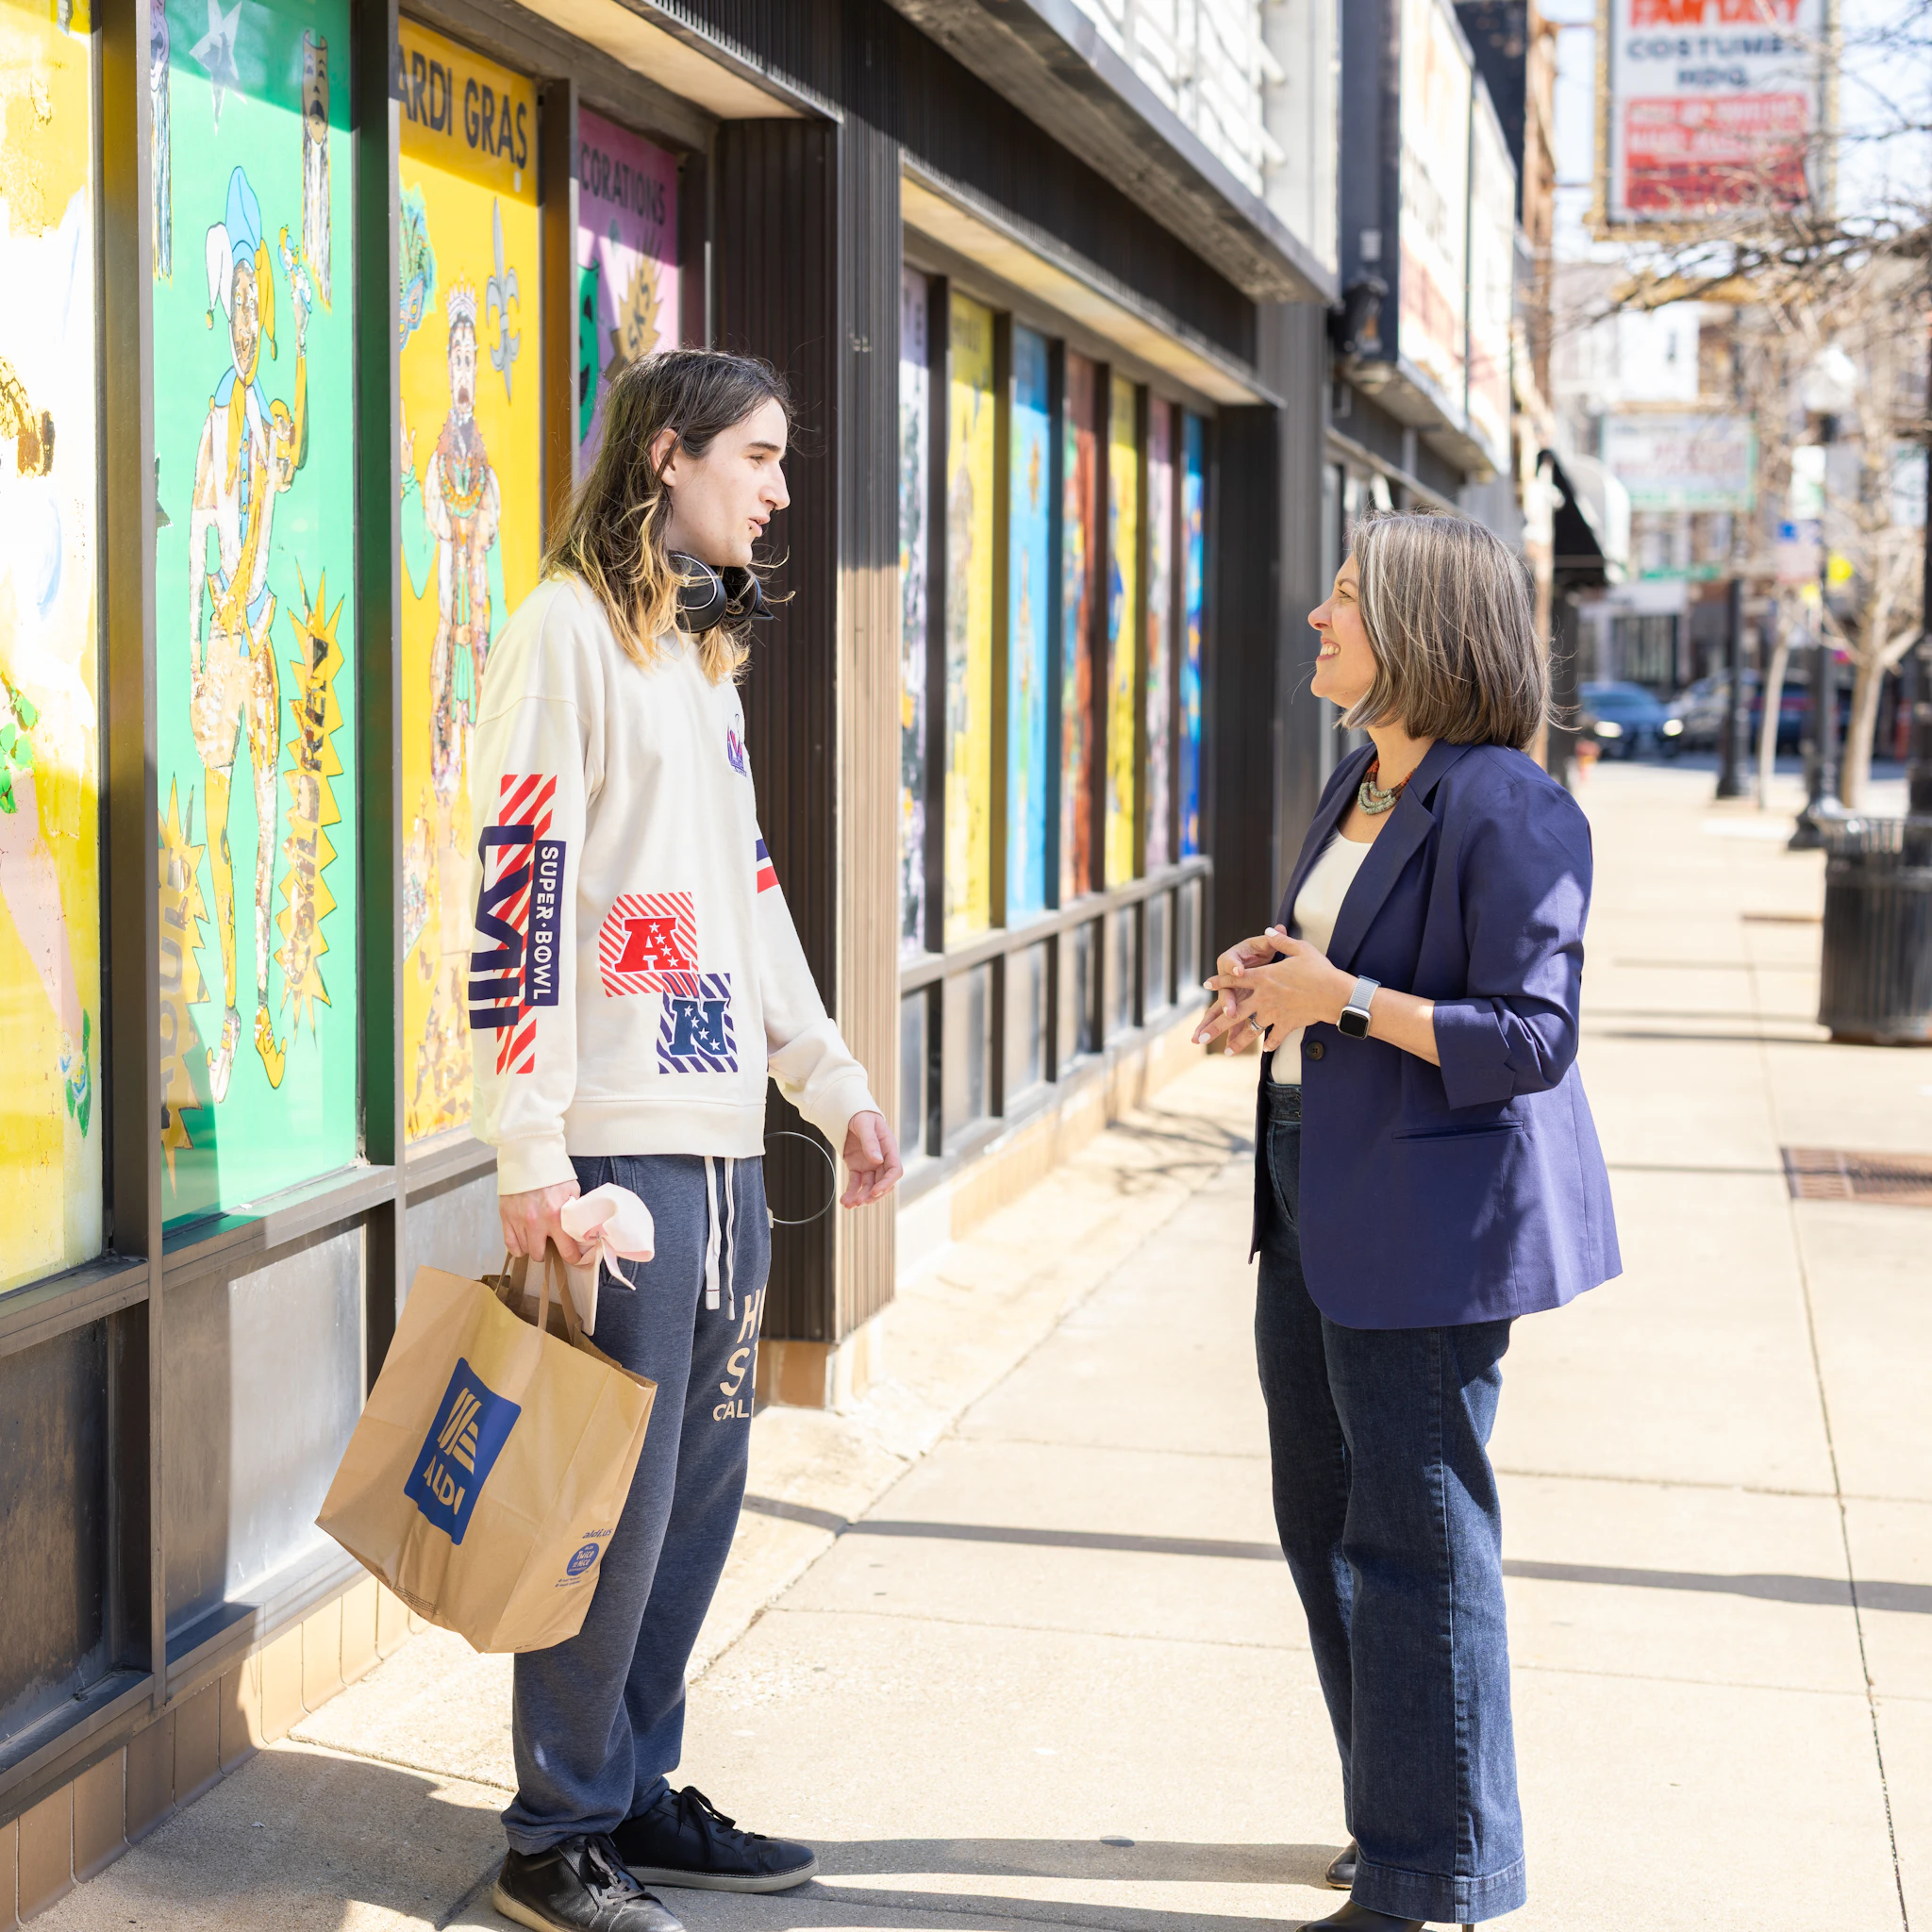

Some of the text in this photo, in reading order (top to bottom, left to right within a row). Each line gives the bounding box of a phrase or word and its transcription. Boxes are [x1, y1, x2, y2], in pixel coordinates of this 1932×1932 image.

[396, 43, 527, 170] ARDI GRAS
[580, 142, 666, 225] CORATIONS
[533, 846, 558, 1000] SUPER BOWL
[737, 1283, 767, 1344] H
[720, 1341, 758, 1396] S
[423, 1454, 466, 1515] ALDI
[582, 1529, 612, 1539] aldi.us
